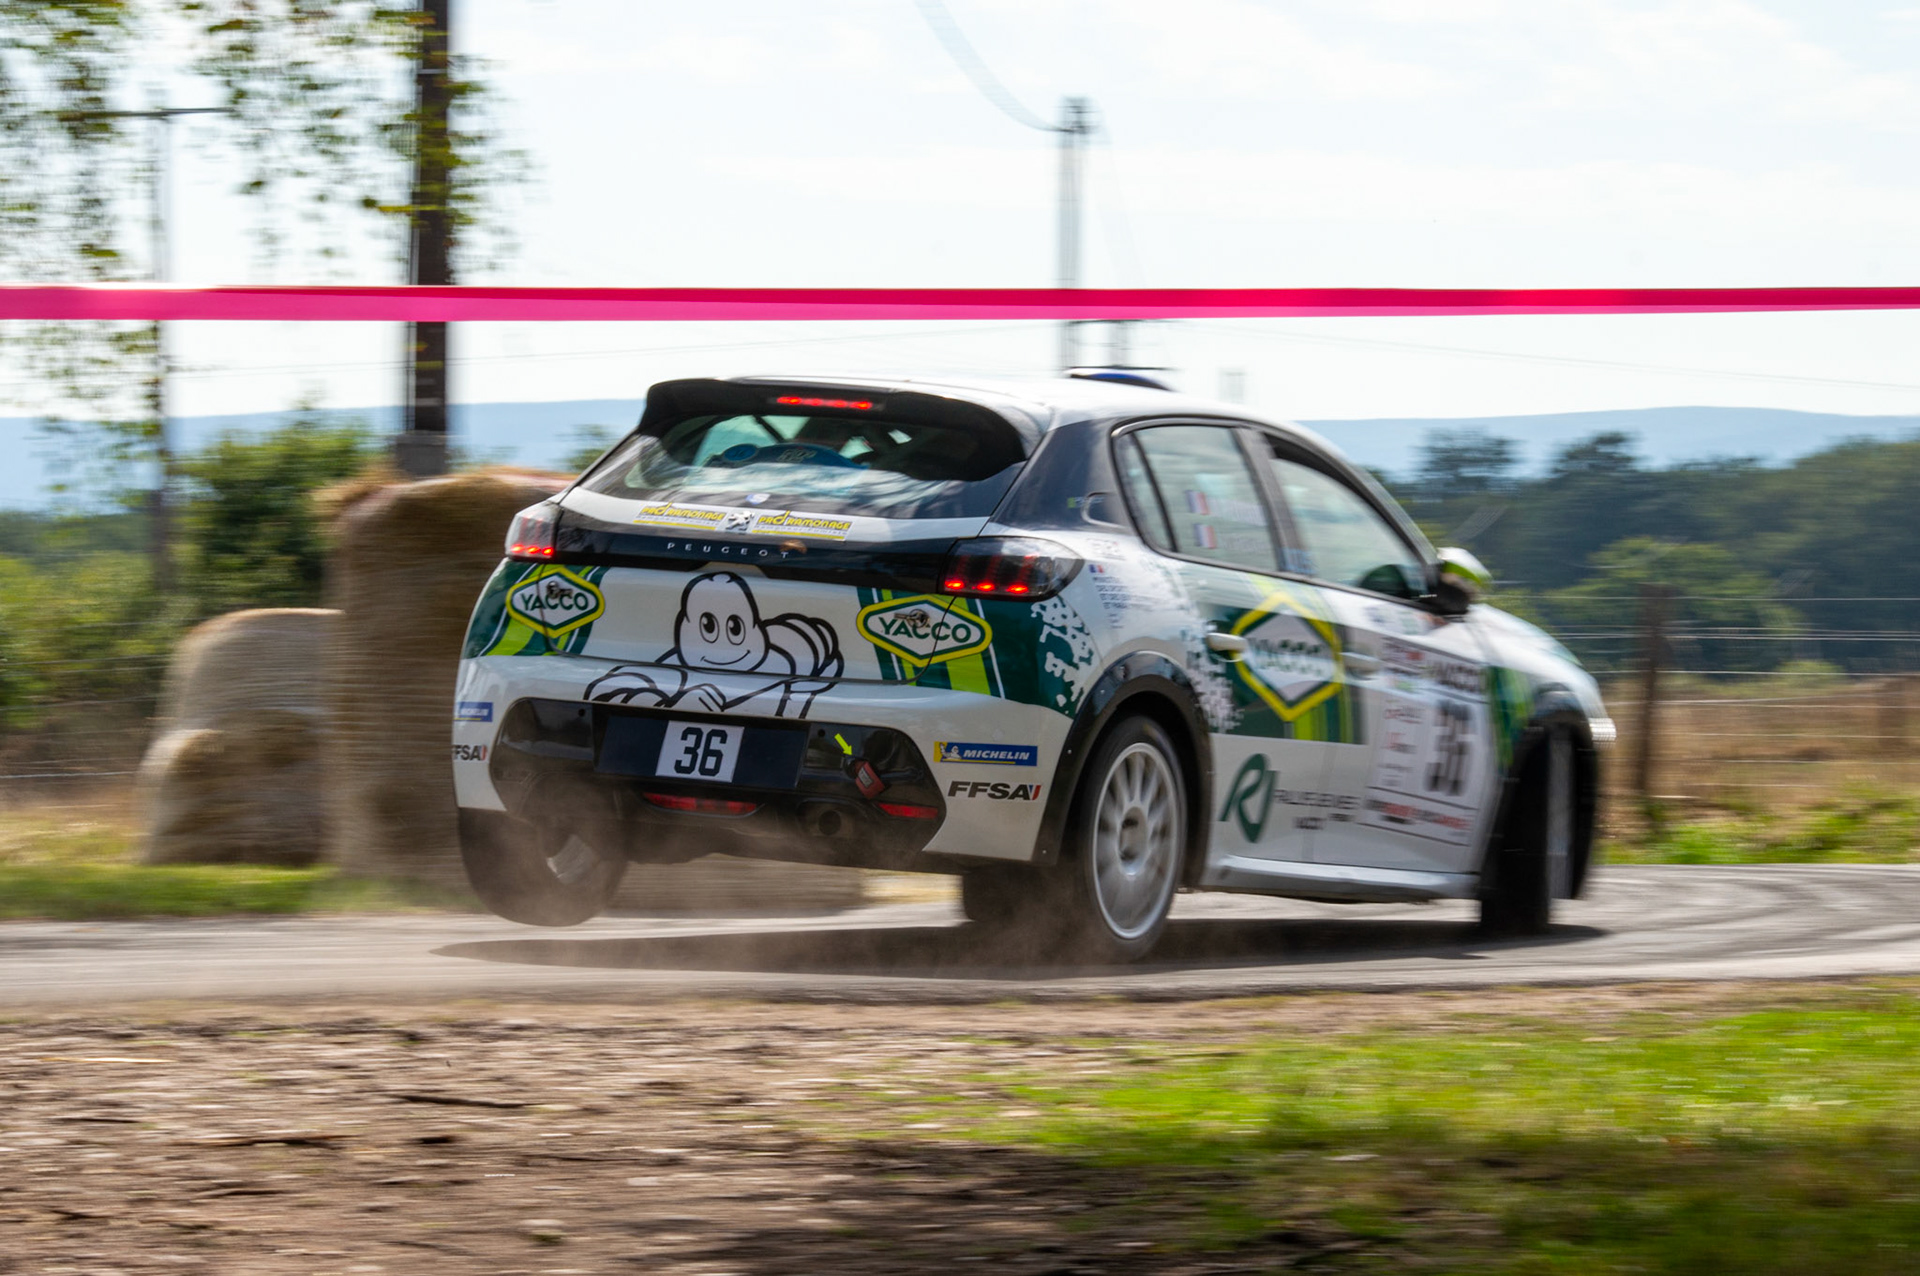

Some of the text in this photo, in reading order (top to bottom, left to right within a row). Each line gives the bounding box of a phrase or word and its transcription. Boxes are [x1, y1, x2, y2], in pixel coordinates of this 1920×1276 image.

[667, 508, 727, 522] RAMONAGE
[786, 516, 852, 531] RAMONAGE
[666, 542, 789, 560] PEUGEOT
[520, 592, 589, 611] YACCO
[877, 616, 972, 643] YACCO
[674, 726, 728, 777] 36
[963, 750, 1030, 761] MICHELIN
[947, 780, 1031, 801] FFSA
